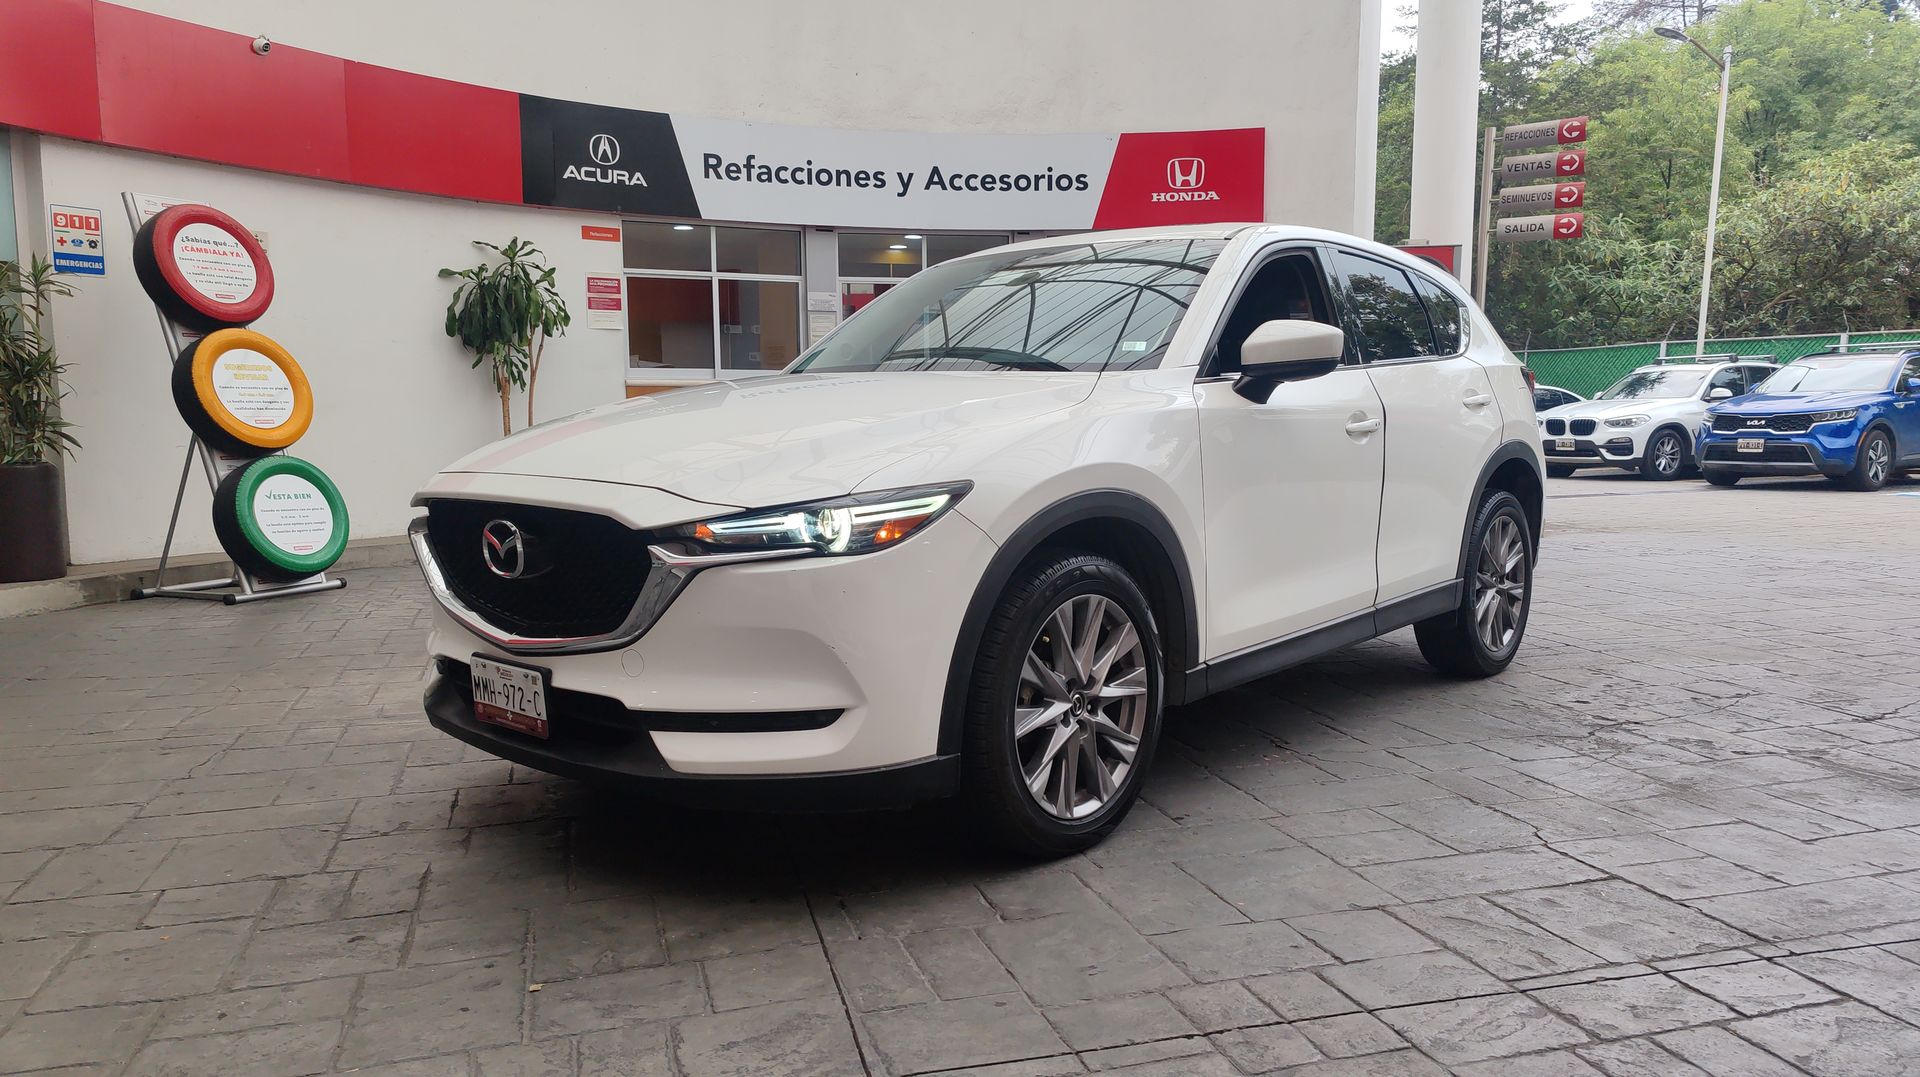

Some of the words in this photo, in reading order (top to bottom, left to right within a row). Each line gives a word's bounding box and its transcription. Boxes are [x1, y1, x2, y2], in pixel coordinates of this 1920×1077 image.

[1505, 128, 1555, 141] REFACCIONES
[1507, 160, 1552, 172] VENTAS
[562, 164, 648, 187] ACURA
[703, 152, 887, 188] Refacciones
[896, 172, 914, 198] y
[924, 165, 1089, 192] Accesorios
[1151, 191, 1220, 202] HONDA
[1501, 192, 1553, 204] SEMINUEVOS
[56, 215, 96, 229] 911
[1505, 223, 1545, 234] SALIDA
[56, 259, 103, 269] EMERGENCIAS
[473, 674, 541, 717] MMH-972-C
